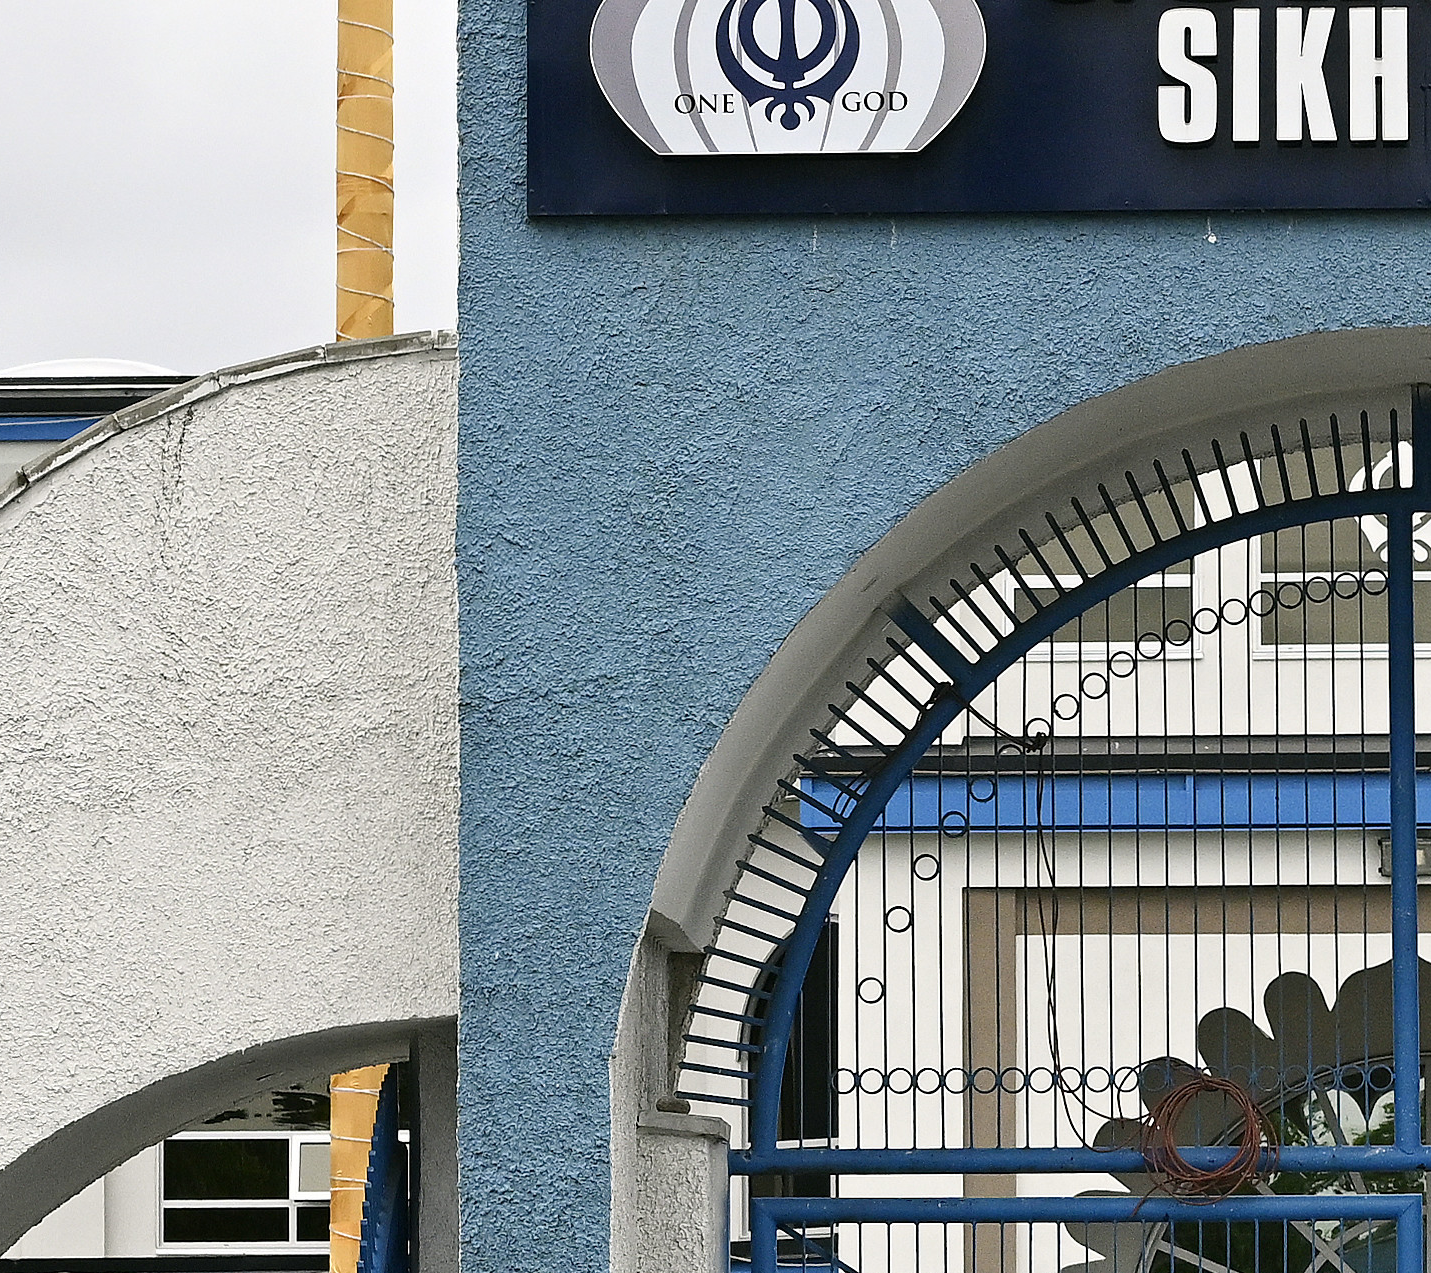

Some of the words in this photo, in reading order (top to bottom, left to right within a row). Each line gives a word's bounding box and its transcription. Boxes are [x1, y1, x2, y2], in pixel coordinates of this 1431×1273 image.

[674, 93, 734, 114] ONE
[841, 91, 908, 112] GOD
[1157, 6, 1410, 143] SIKH
